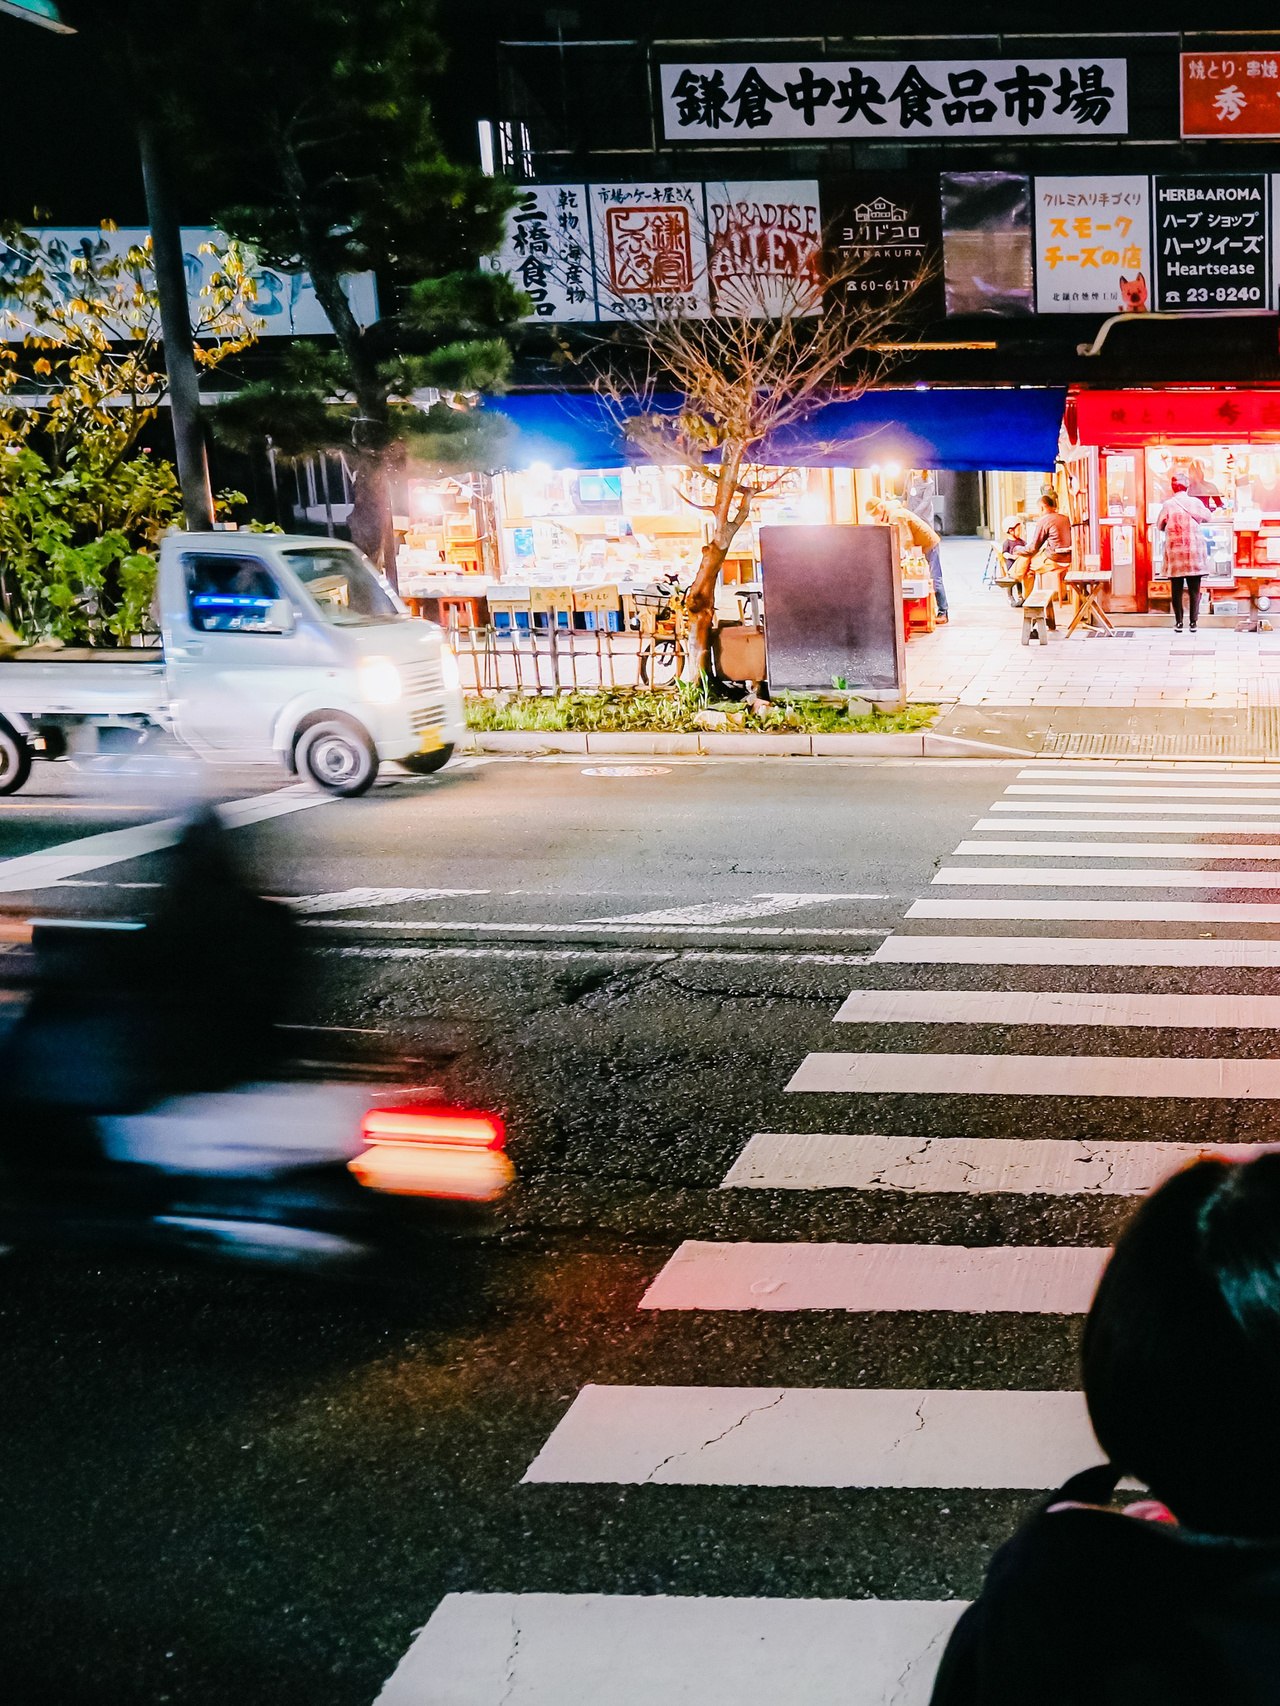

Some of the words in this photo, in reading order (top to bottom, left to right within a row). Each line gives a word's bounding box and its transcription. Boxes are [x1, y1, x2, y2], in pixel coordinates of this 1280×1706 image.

[671, 64, 1116, 129] 鎌倉中央食品市場
[598, 187, 695, 204] 市場のケーキ屋さん
[1043, 192, 1142, 207] クルミ入り手づくり
[1159, 188, 1262, 202] HERB&AROMA
[711, 202, 817, 234] PARADISE
[1049, 215, 1134, 239] スモーク
[1163, 211, 1203, 228] ハーブ
[1207, 211, 1260, 228] ショップ
[843, 224, 920, 241] ヨリドコロ
[512, 191, 557, 316] 三橋食品
[711, 227, 821, 276] ALLEY
[1163, 235, 1264, 255] ハーツイーズ
[1044, 243, 1143, 270] チーズの店
[1167, 262, 1256, 277] Heartsease
[1186, 287, 1261, 302] 23-8240
